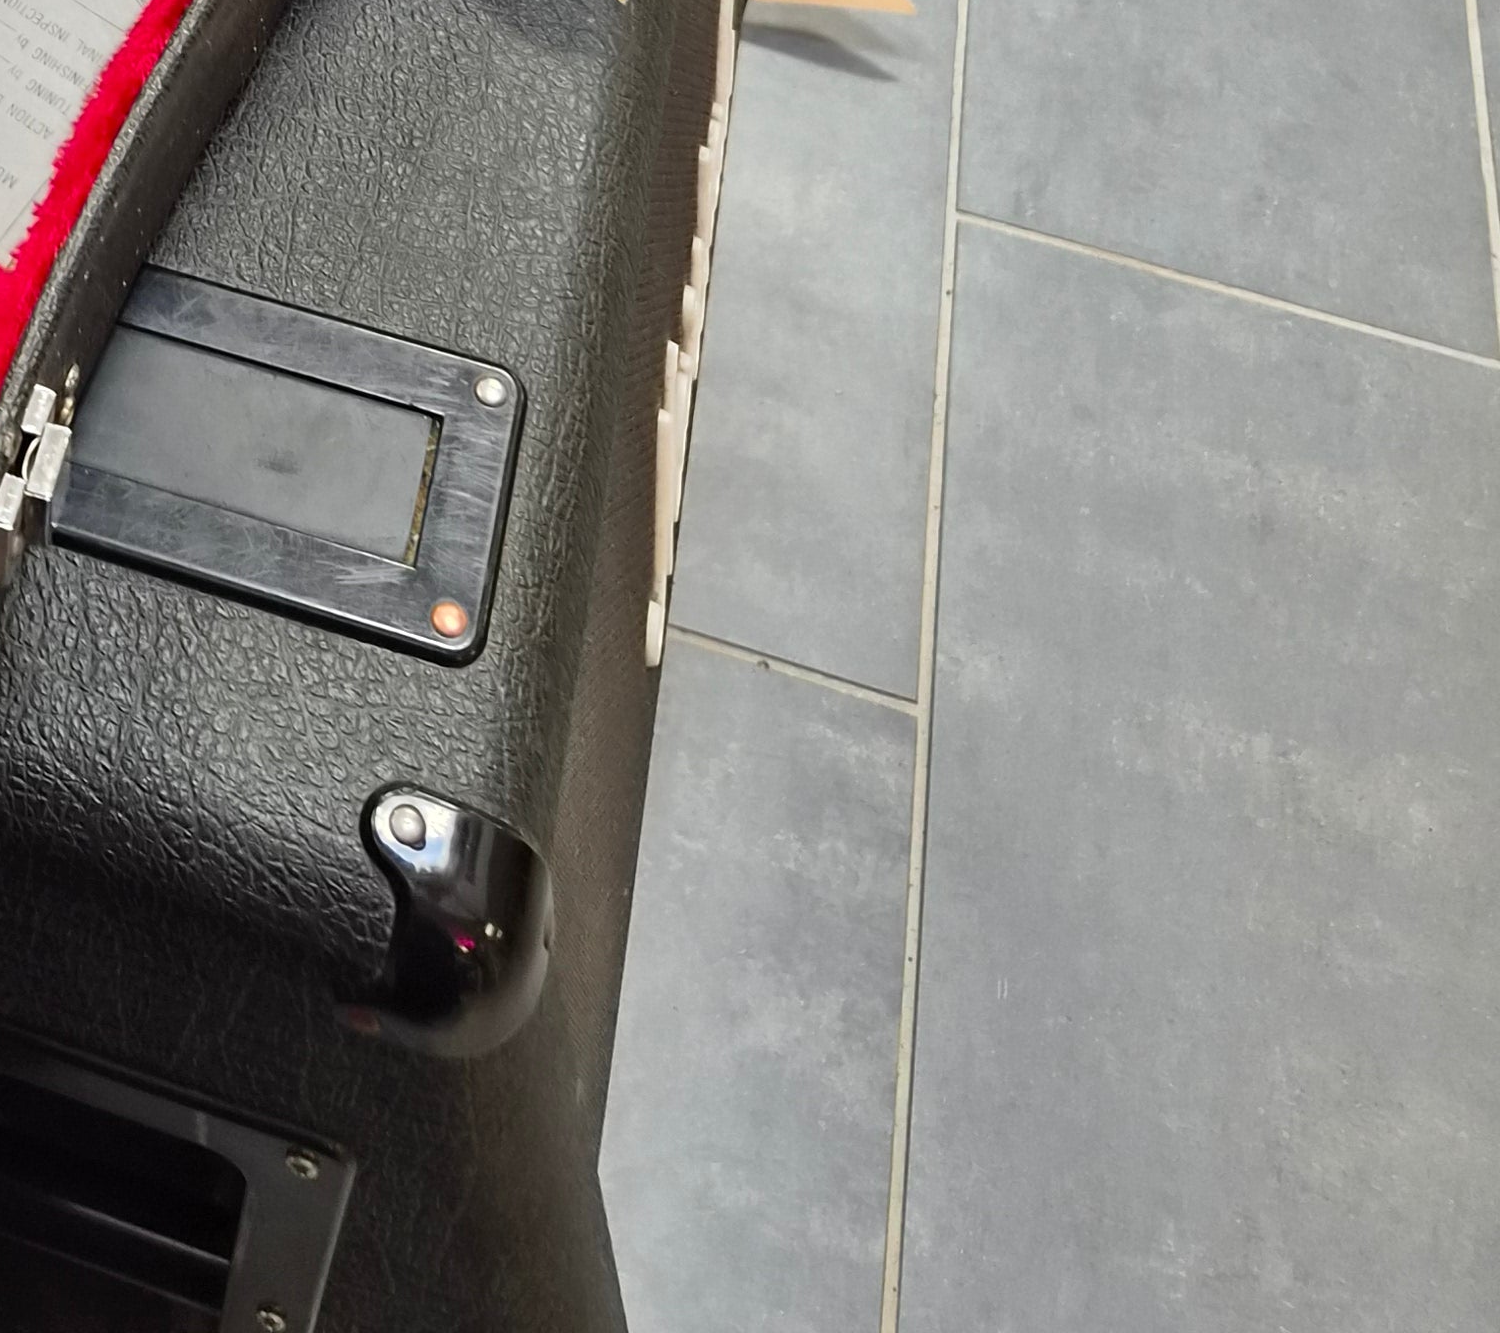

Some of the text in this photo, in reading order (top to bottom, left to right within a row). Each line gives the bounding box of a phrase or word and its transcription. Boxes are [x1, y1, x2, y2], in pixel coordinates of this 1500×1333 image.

[16, 34, 29, 50] by
[76, 37, 105, 68] INAL
[8, 63, 72, 117] TUNING by
[6, 103, 56, 140] ACTION
